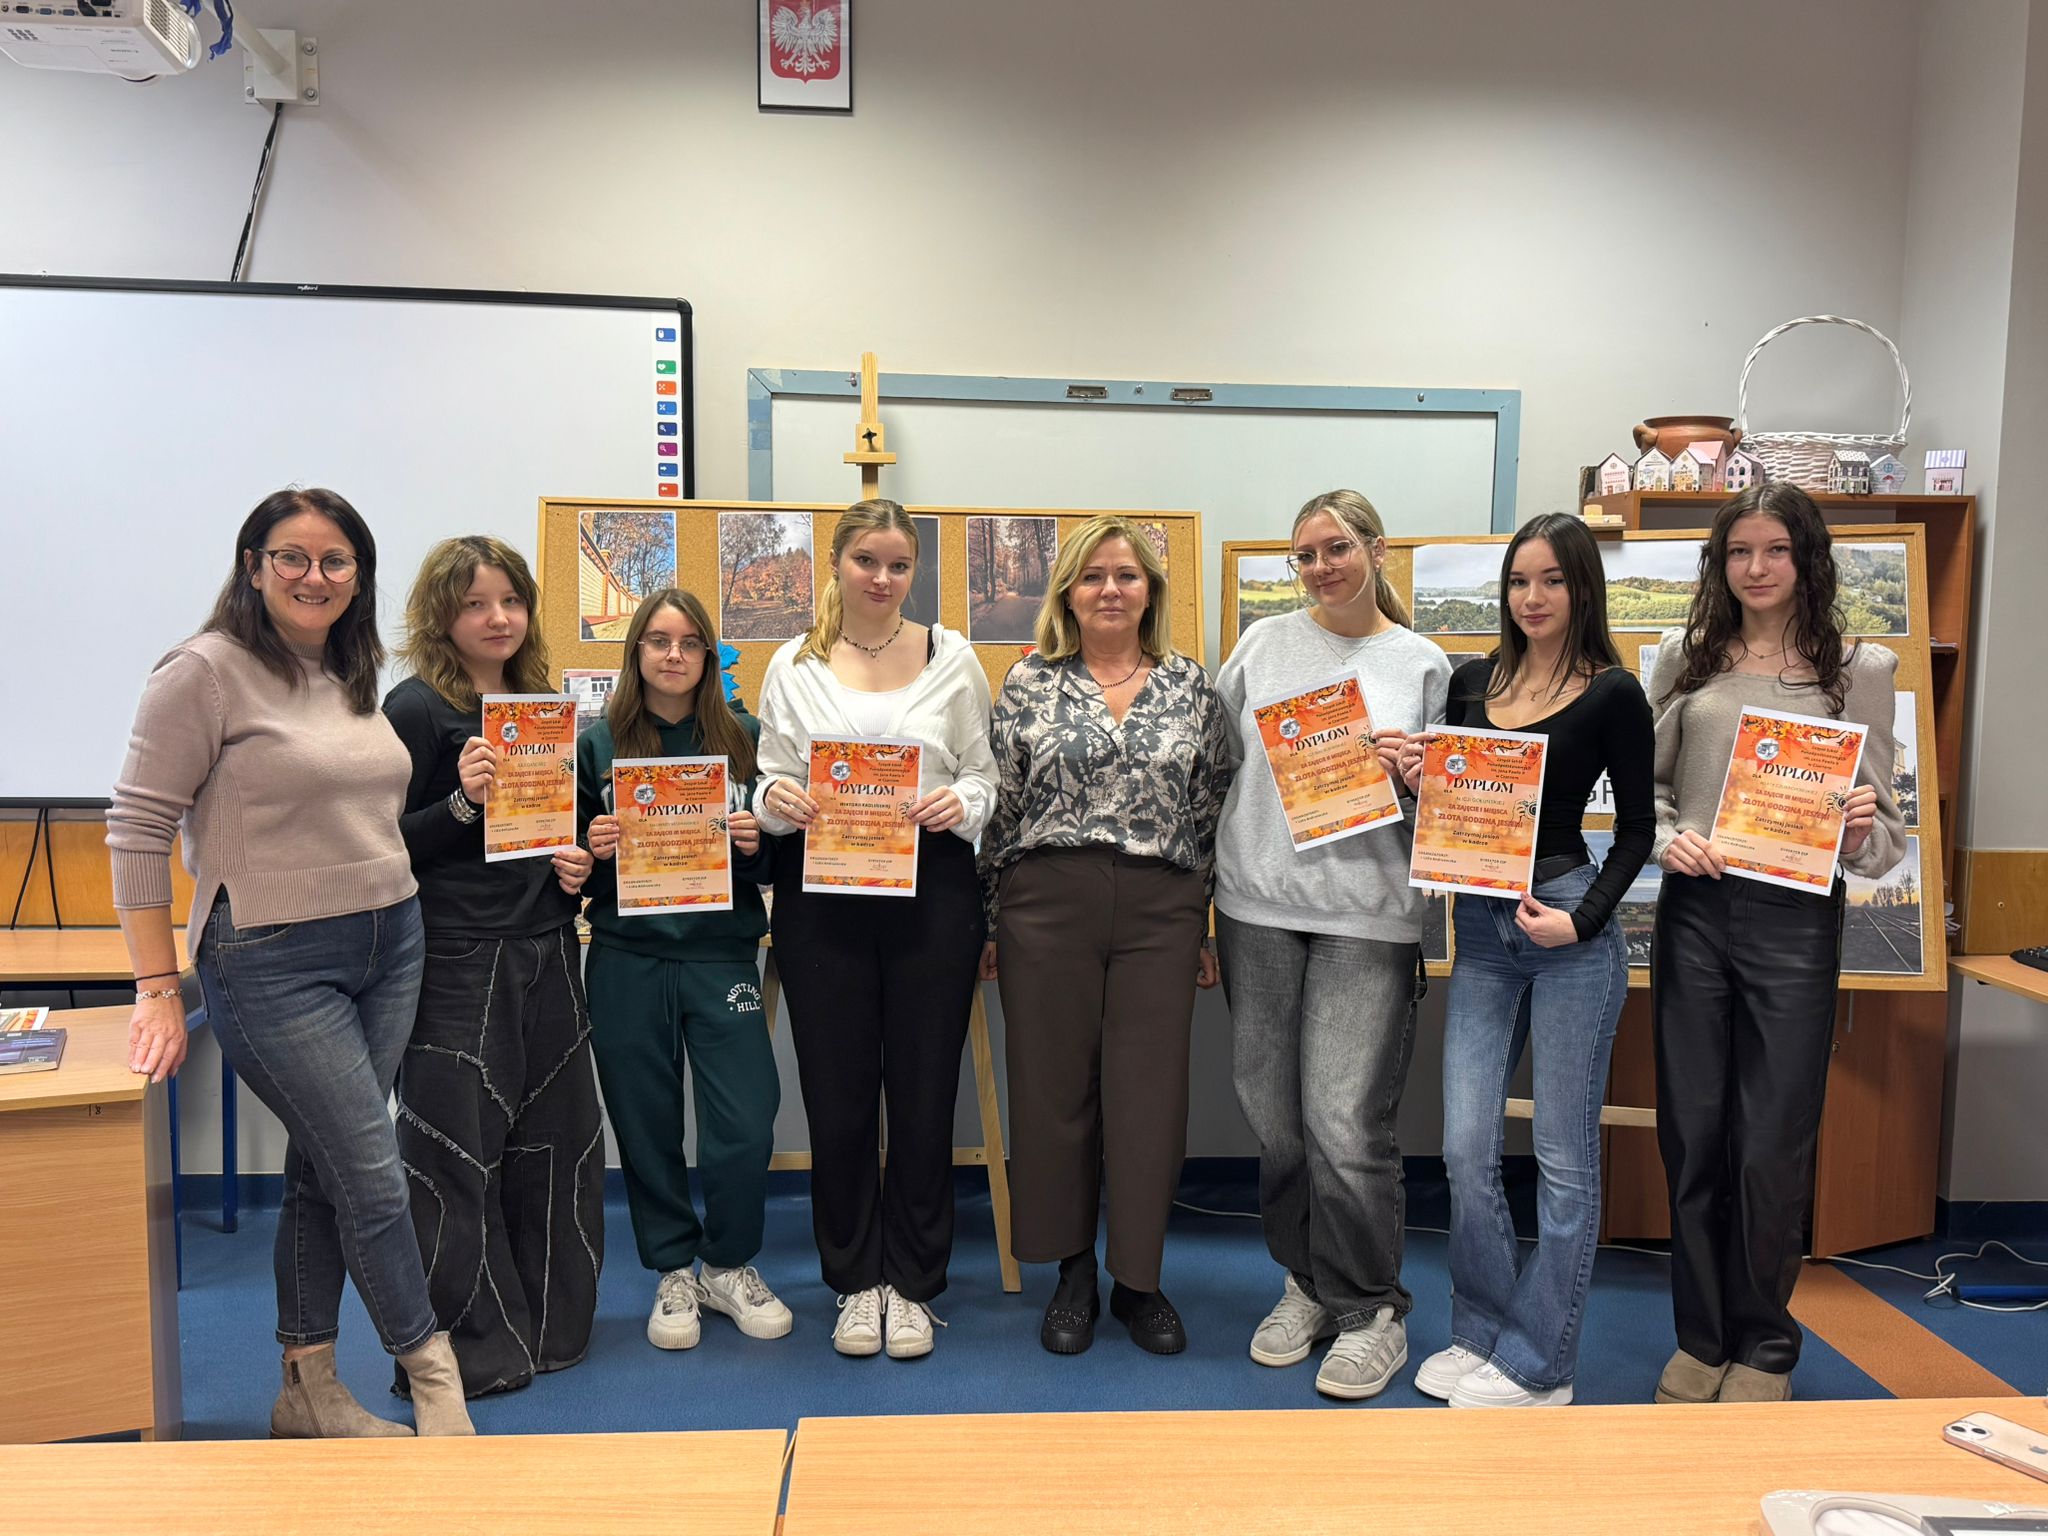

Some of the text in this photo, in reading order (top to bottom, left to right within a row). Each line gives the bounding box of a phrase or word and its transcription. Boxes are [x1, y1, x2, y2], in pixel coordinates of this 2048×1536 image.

[1296, 726, 1349, 751] DYPLOM
[510, 743, 555, 756] DYPLOM
[1331, 749, 1351, 760] MIEJSCA
[1295, 771, 1316, 783] ZŁOTA
[1316, 761, 1347, 776] GODZINA
[1763, 763, 1825, 783] DYPLOM
[519, 780, 546, 788] GODZINA
[840, 784, 894, 796] DYPLOM
[1313, 779, 1339, 791] Zatrzymaj
[1454, 778, 1513, 794] DYPLOM
[1743, 798, 1767, 808] ZŁOTA
[1767, 802, 1803, 814] GODZINA
[1792, 796, 1815, 805] MIEJSCA
[647, 804, 703, 816] DYPLOM
[1484, 807, 1508, 815] MIEJSCA
[849, 819, 881, 827] GODZINA
[1438, 813, 1462, 821] ZŁOTA
[1462, 816, 1497, 825] GODZINA
[1755, 816, 1785, 827] Zatrzymaj
[1452, 830, 1481, 838] Zatrzymaj
[1771, 827, 1791, 835] kadrze
[660, 839, 692, 847] GODZINA
[727, 983, 761, 1003] NOTTING
[737, 1001, 761, 1012] HILL
